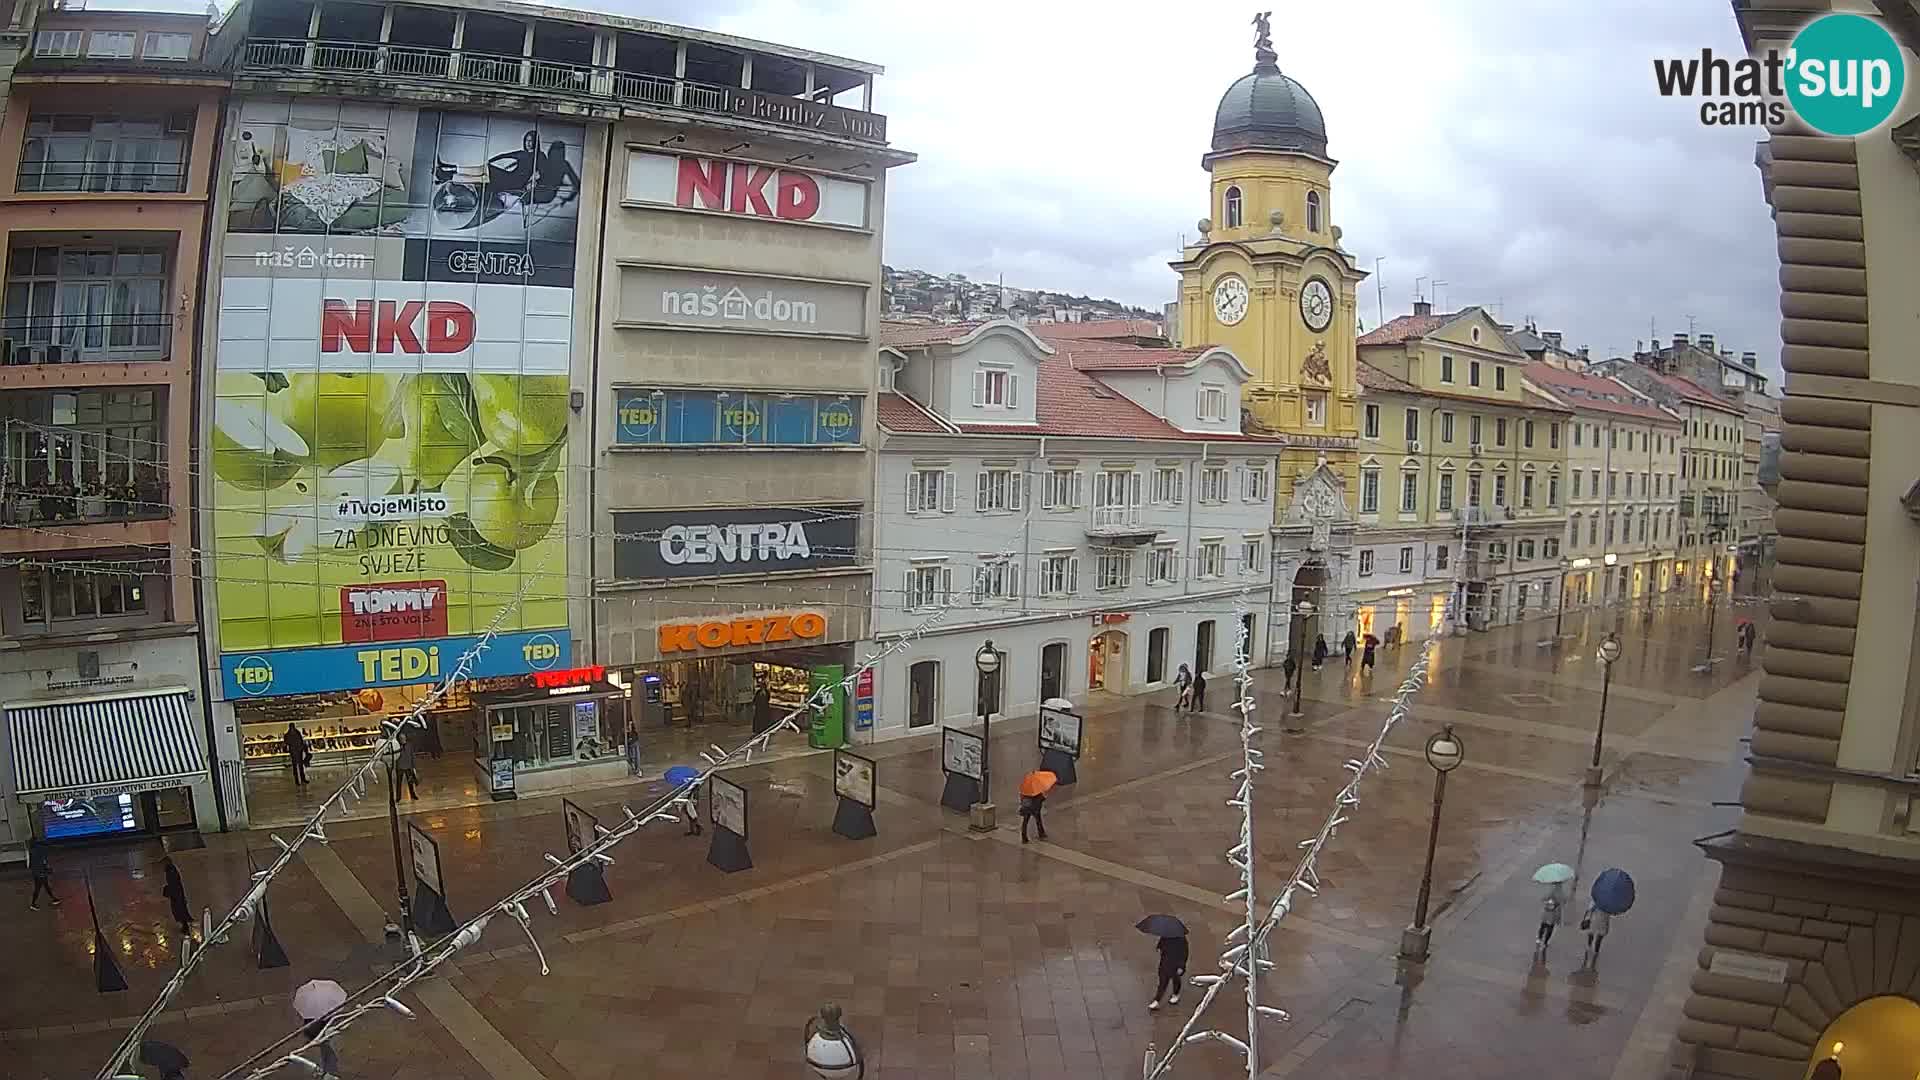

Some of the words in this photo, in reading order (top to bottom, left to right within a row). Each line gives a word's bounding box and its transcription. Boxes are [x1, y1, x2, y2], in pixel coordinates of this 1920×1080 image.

[724, 90, 746, 111] Le
[676, 158, 821, 221] NKD
[255, 246, 295, 267] naš
[319, 247, 366, 269] dom
[448, 250, 535, 276] CENTRA
[662, 285, 718, 317] naš
[754, 291, 817, 323] dom
[321, 298, 477, 354] NKD
[619, 408, 658, 425] TEDi
[724, 409, 759, 427] TEDi
[820, 411, 853, 427] TEDi
[338, 498, 446, 517] #TvojeMisto
[333, 529, 358, 549] ZA
[367, 524, 450, 549] DNEVNO
[660, 522, 811, 565] CENTRA
[359, 549, 426, 576] SVJEŽE
[349, 588, 438, 615] TOMMY
[355, 618, 376, 628] ZN
[658, 613, 826, 655] KORZO
[358, 646, 440, 682] TEDi
[522, 643, 560, 661] TEDi
[234, 666, 273, 684] TEDi
